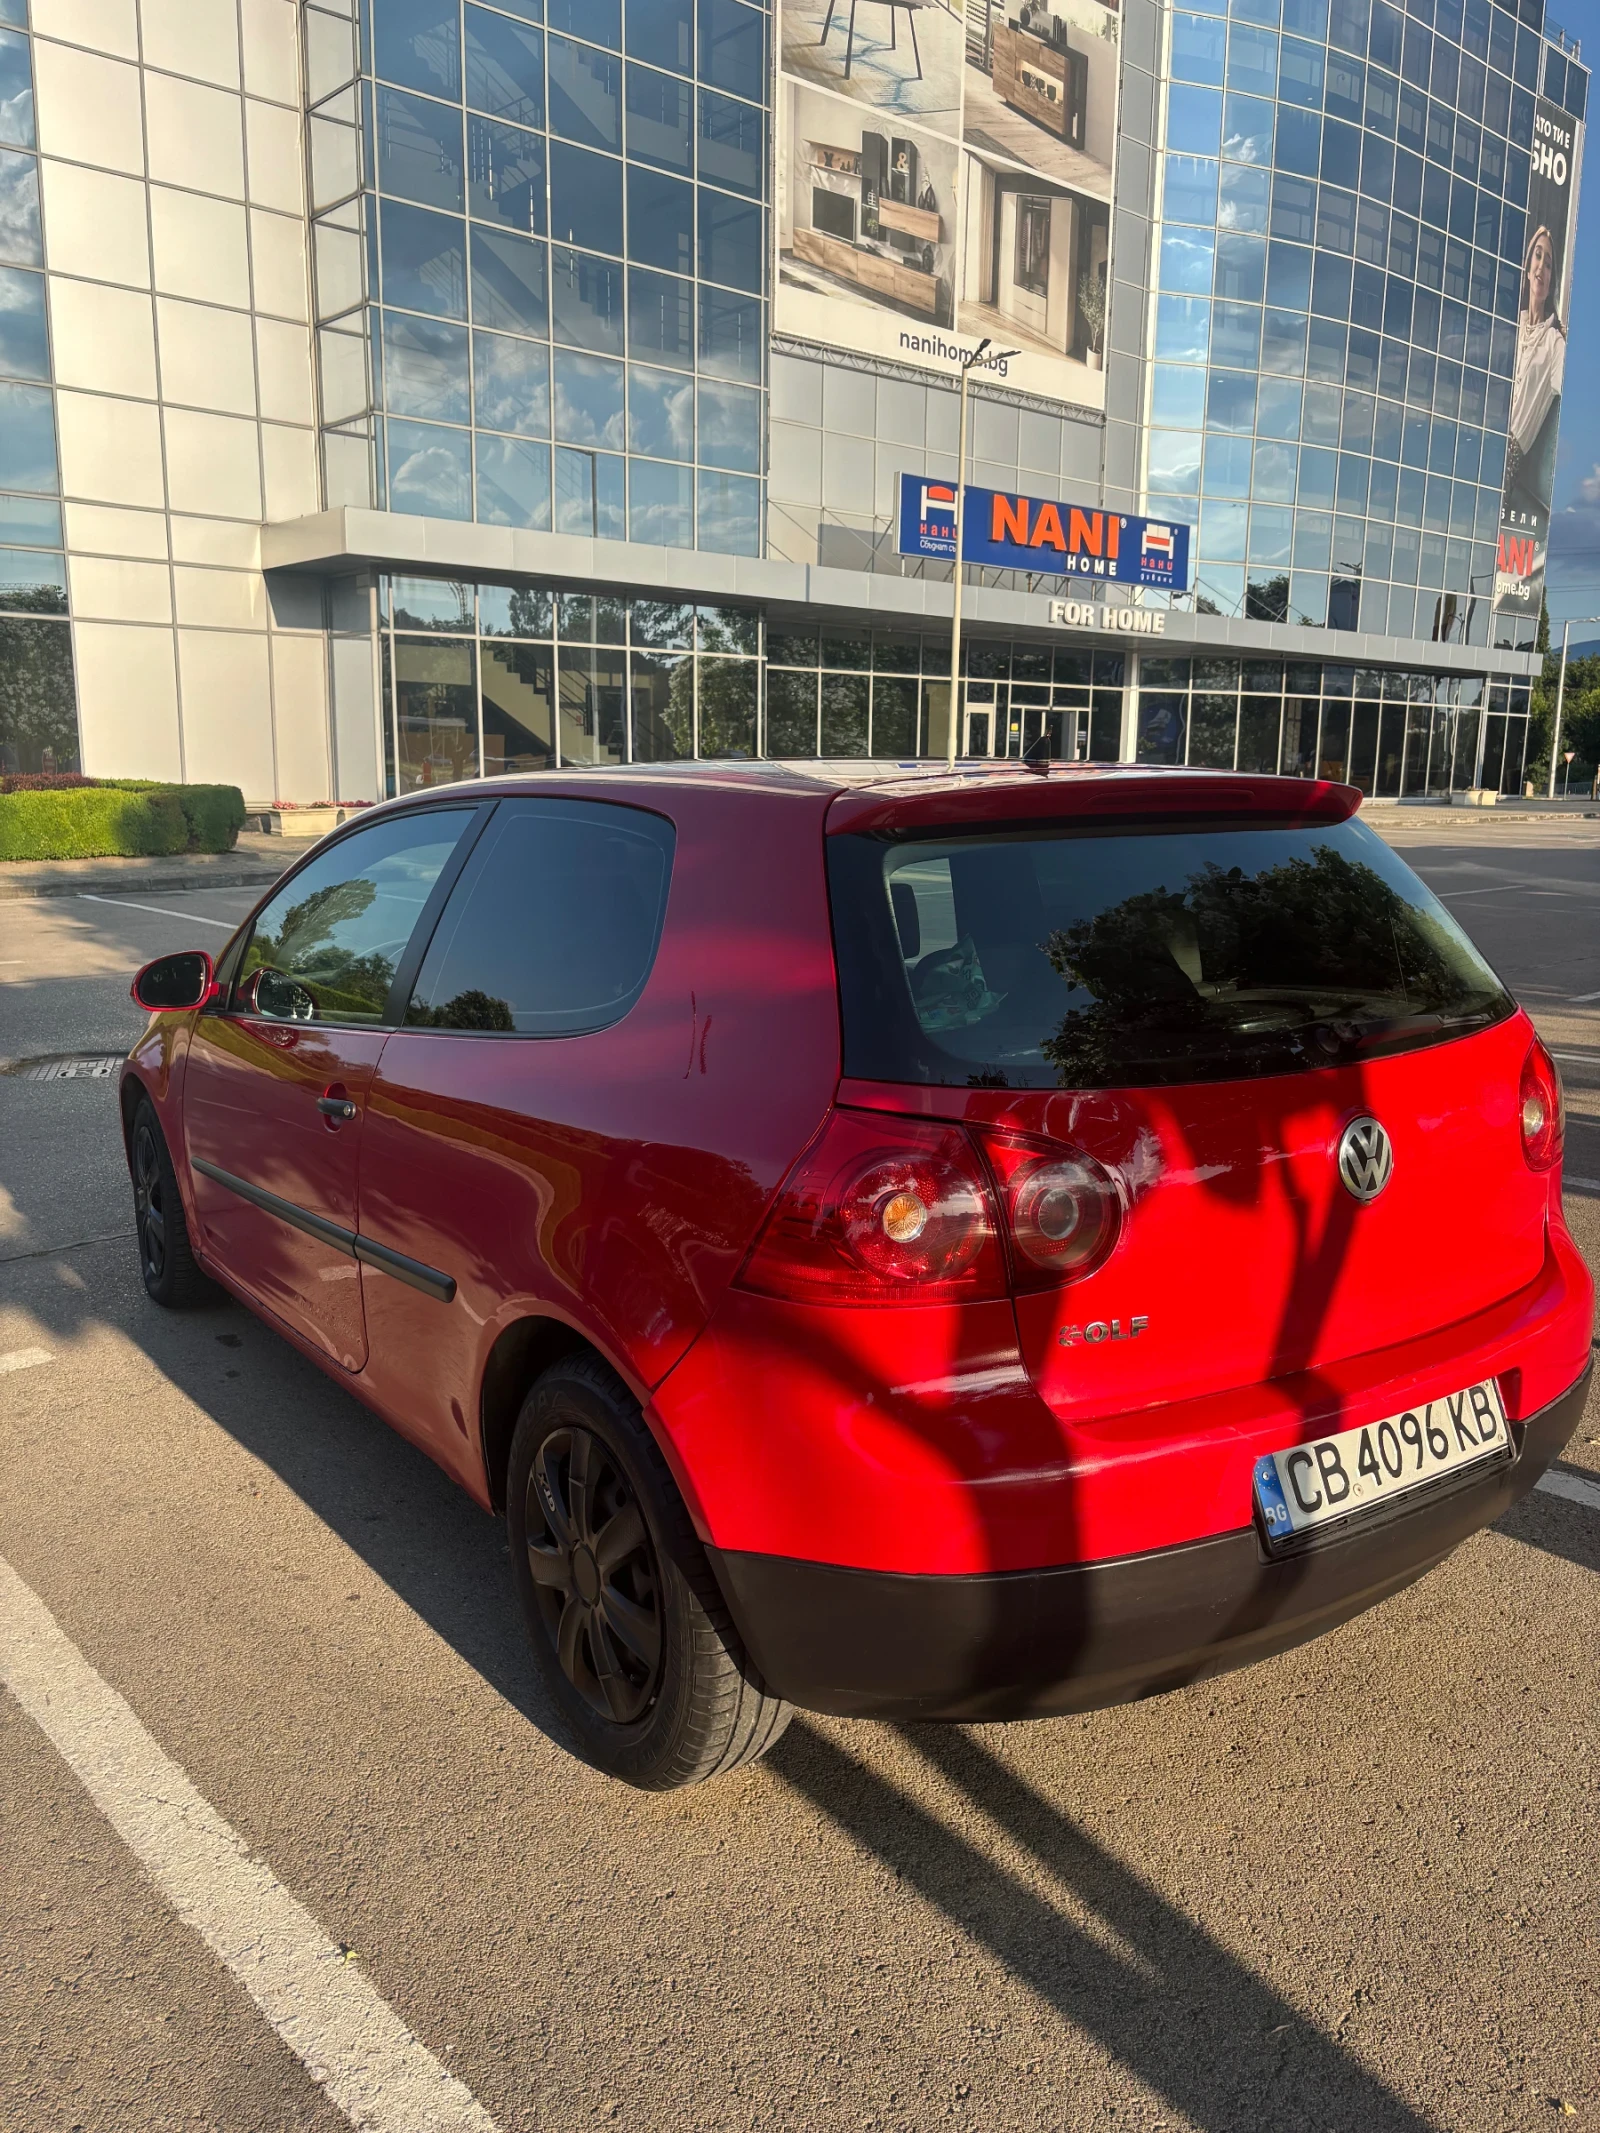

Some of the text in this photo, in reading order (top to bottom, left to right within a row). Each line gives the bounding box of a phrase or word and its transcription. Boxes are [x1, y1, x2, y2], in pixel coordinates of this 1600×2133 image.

[991, 493, 1120, 559] NANI
[1066, 555, 1117, 576] HOME
[1050, 600, 1166, 634] FOR HOME
[1286, 1385, 1498, 1514] CB 4096 KB
[1264, 1503, 1288, 1525] BG
